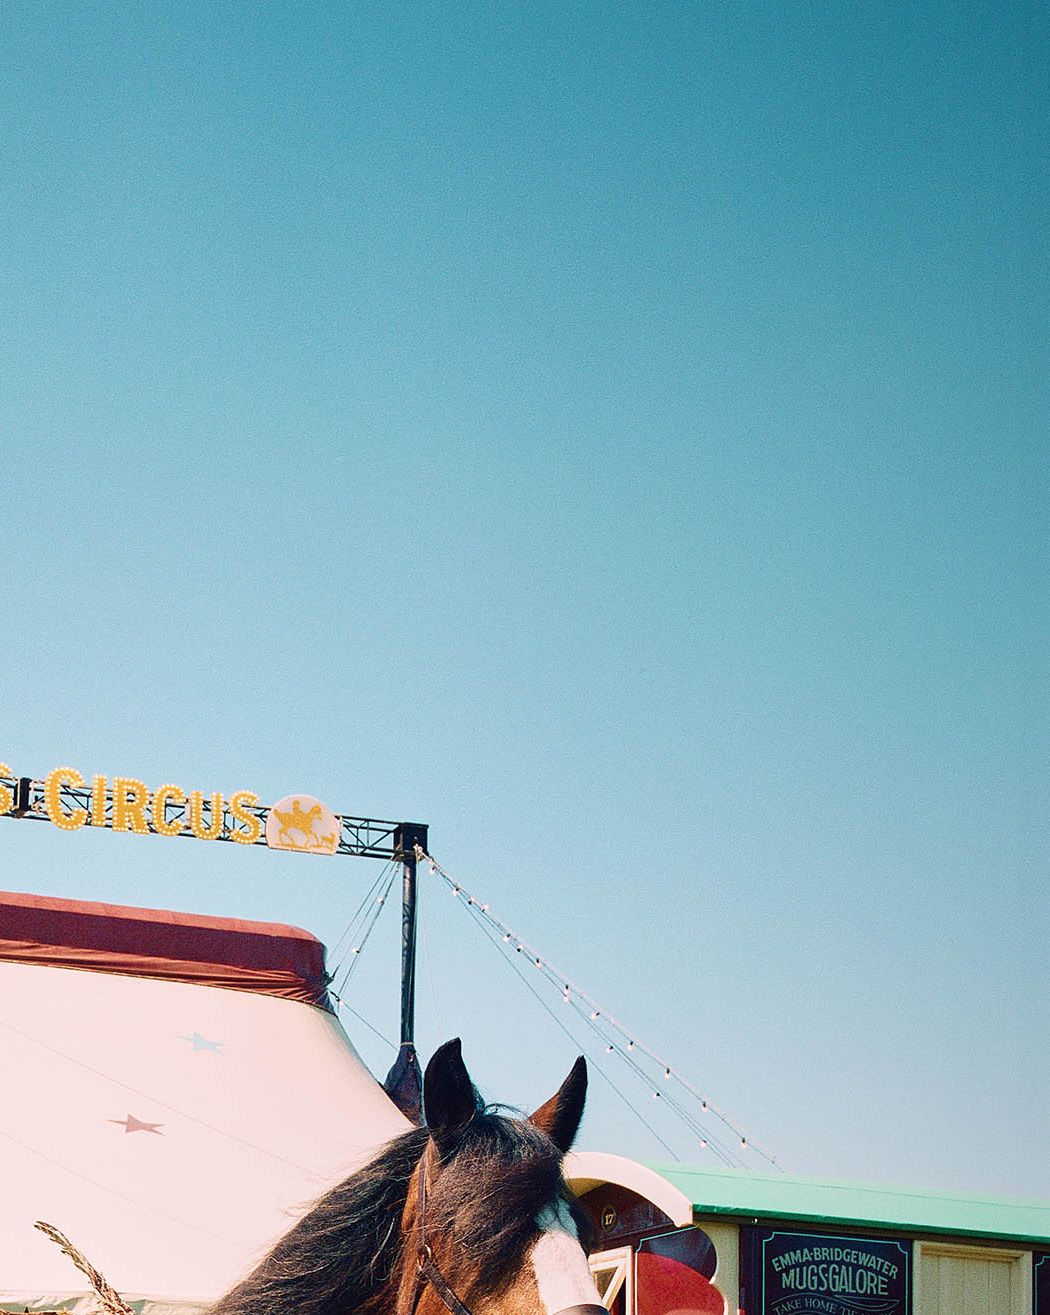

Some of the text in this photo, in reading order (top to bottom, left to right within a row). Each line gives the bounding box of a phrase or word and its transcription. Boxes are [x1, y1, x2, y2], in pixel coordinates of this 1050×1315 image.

[45, 767, 262, 845] CIRCUS
[605, 1213, 614, 1225] 17
[773, 1299, 801, 1315] TAKE
[805, 1298, 837, 1314] HOME
